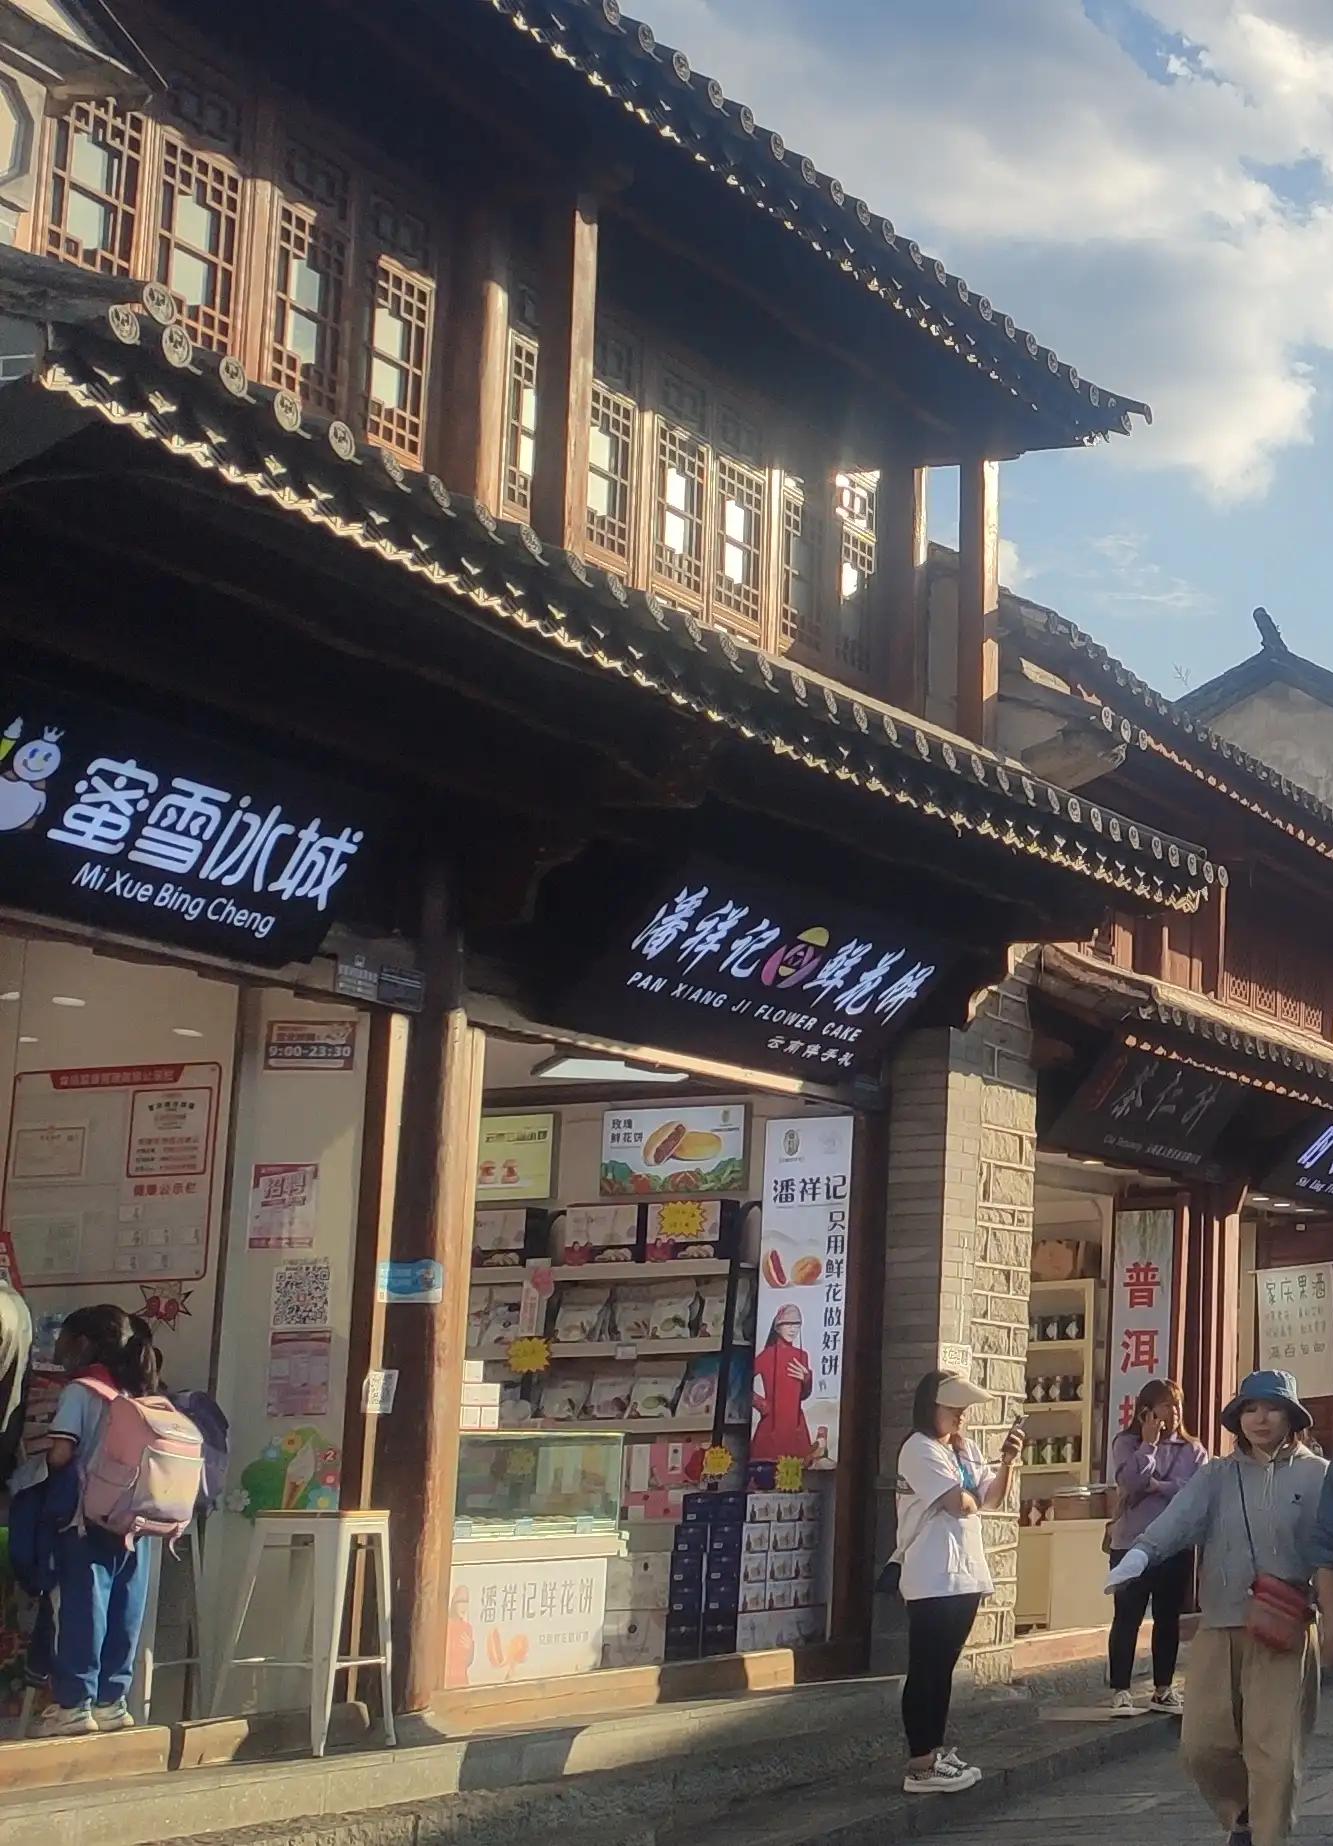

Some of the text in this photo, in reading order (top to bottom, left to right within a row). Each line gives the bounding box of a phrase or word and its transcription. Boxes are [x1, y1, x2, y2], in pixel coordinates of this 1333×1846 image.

[47, 758, 363, 911] 蜜雪冰城
[72, 861, 276, 939] Mi Xue Bing Cheng
[631, 885, 780, 978] 潘祥记
[627, 971, 862, 1042] PAN XIANG JI FLOWER CAKE
[268, 1045, 352, 1057] 9:00-23:30
[610, 1132, 643, 1144] 鲜花饼
[773, 1175, 847, 1203] 潘祥记
[821, 1211, 846, 1376] 只用鲜花做好饼
[480, 1578, 594, 1623] 潘祥记鲜花饼
